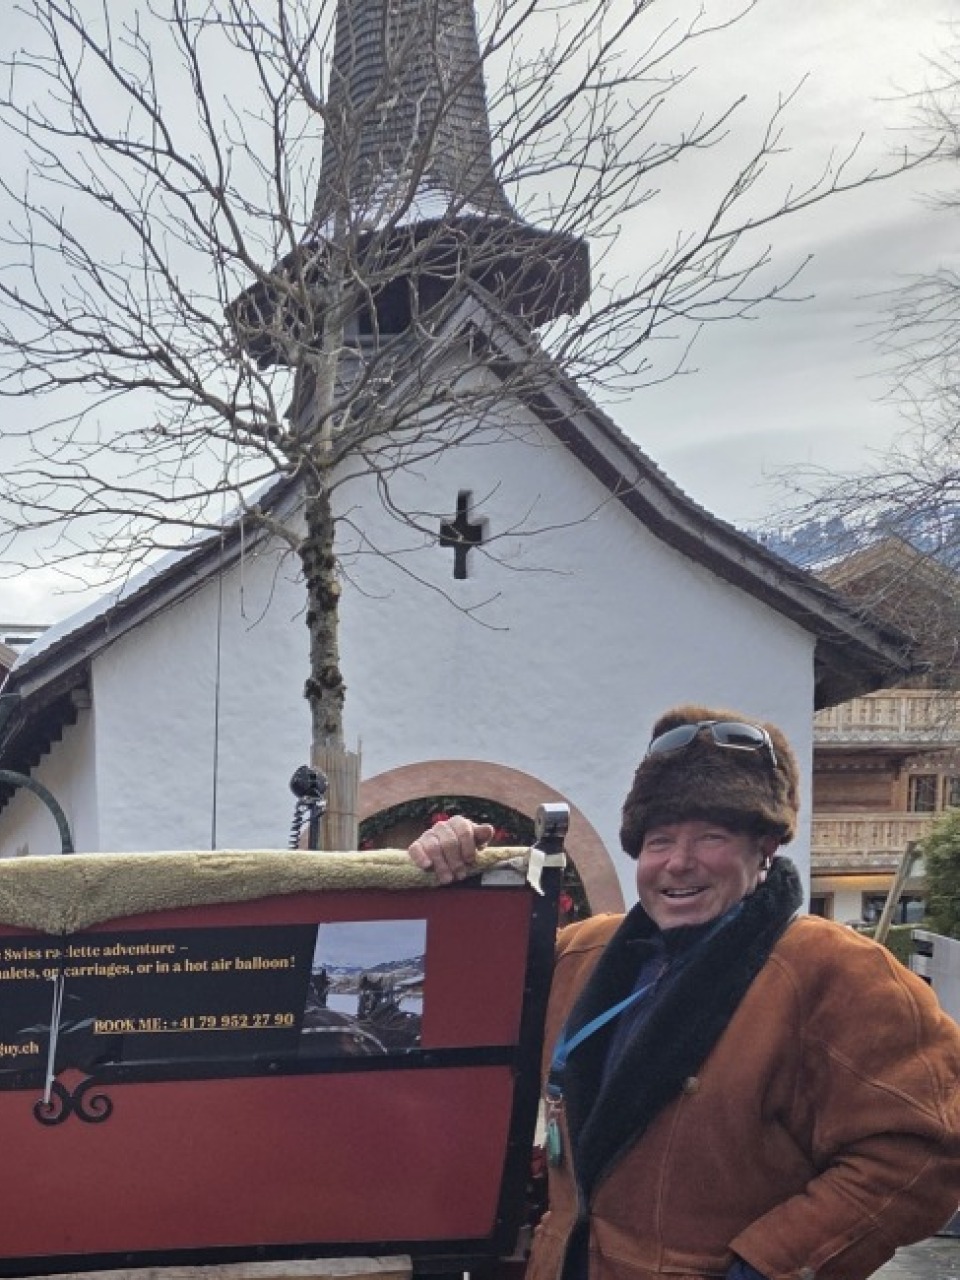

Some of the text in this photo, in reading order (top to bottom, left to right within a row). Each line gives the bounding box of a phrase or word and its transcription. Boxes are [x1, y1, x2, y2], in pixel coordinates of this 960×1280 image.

[4, 947, 42, 960] Swiss
[103, 943, 175, 956] adventure
[64, 963, 134, 978] carriages,
[136, 964, 153, 974] or
[156, 960, 169, 974] in
[172, 963, 182, 972] a
[185, 959, 208, 972] hot
[211, 958, 231, 971] air
[234, 956, 296, 970] balloon!
[94, 1019, 136, 1031] BOOK
[138, 1017, 167, 1030] ME:
[199, 1015, 216, 1028] 79
[221, 1013, 248, 1027] 952
[252, 1013, 271, 1027] 27
[274, 1012, 295, 1026] 90
